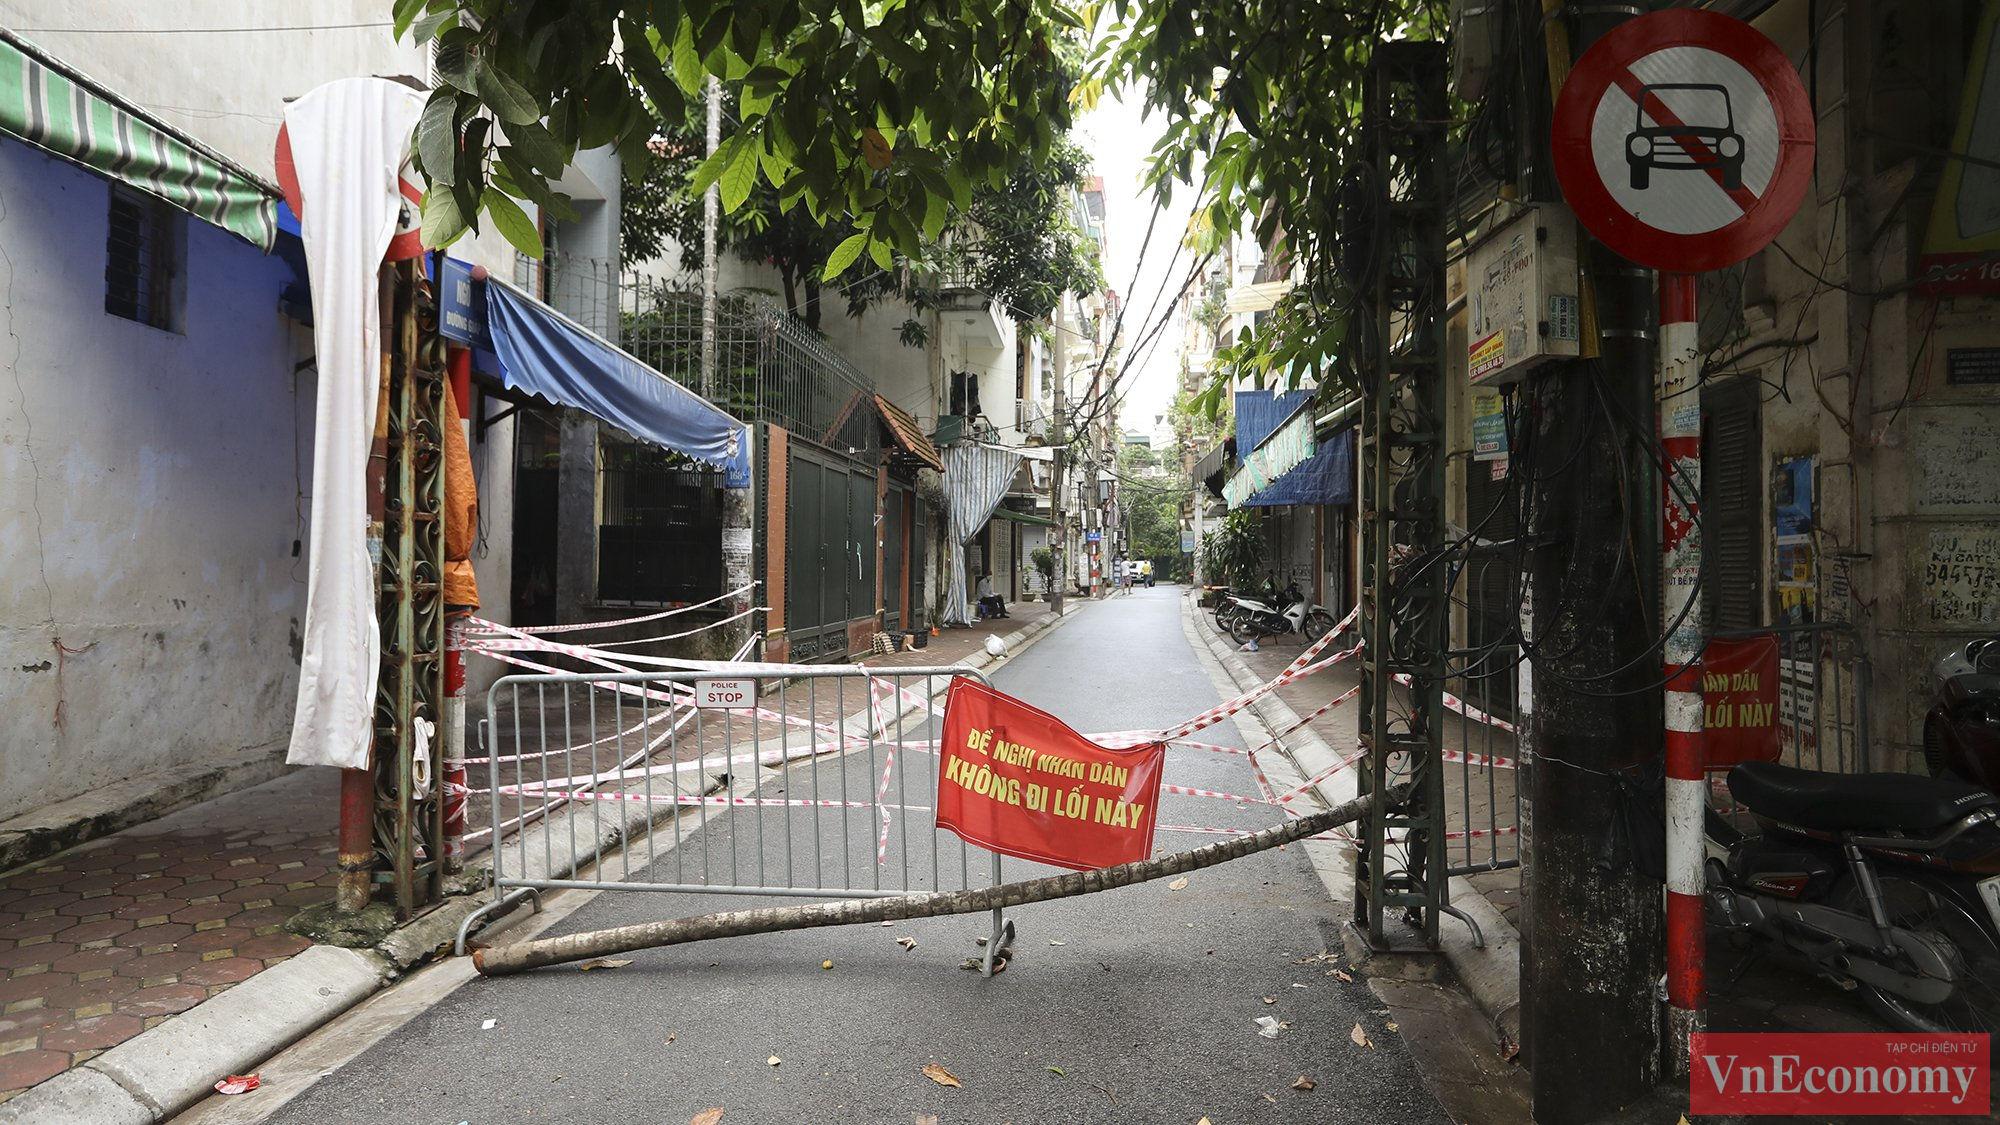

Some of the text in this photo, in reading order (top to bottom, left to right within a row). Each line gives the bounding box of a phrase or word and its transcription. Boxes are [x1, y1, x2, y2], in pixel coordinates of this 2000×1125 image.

[1732, 668, 1759, 692] DÂN
[708, 692, 743, 703] STOP
[1704, 695, 1733, 728] LỐI
[1740, 698, 1773, 728] NÀY
[966, 727, 994, 756] ĐỀ
[993, 740, 1037, 773] NGHỊ
[1089, 761, 1129, 788] DÂN
[945, 754, 1144, 830] KHÔNG ĐI LỐI NÀY
[1953, 791, 1988, 805] HONDA
[1777, 822, 1808, 835] HONDA
